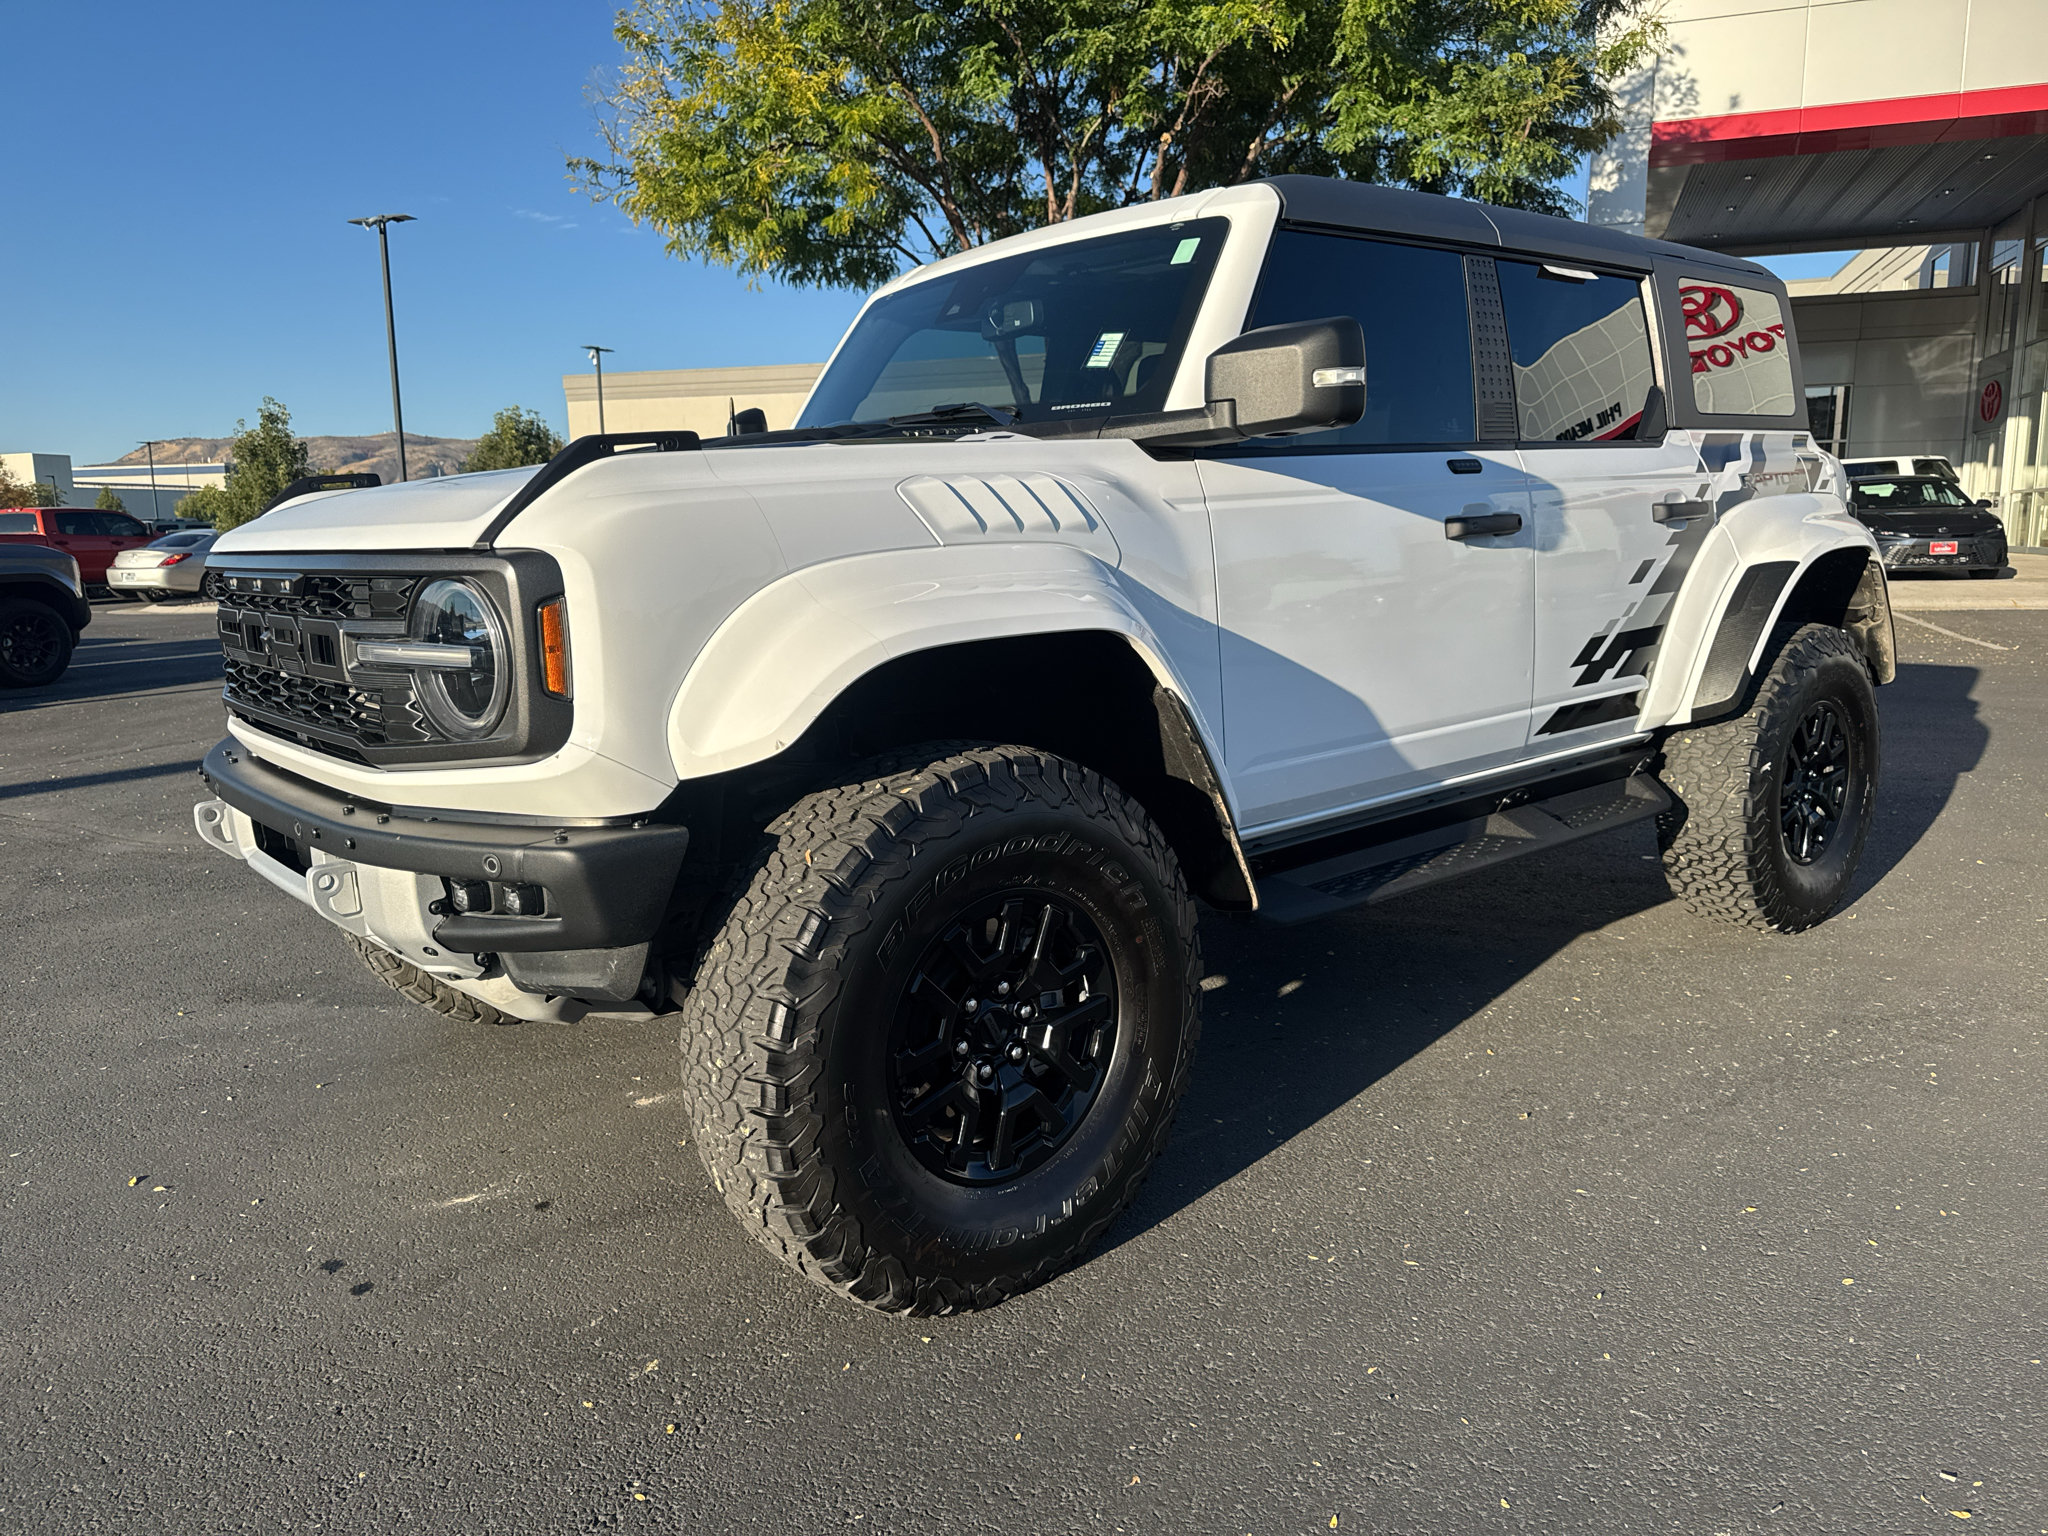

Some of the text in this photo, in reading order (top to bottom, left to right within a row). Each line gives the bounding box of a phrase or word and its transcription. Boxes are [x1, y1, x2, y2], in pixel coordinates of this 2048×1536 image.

[1051, 401, 1111, 411] BRONCO
[216, 605, 351, 684] FORD
[875, 831, 1148, 974] BFGoodrich
